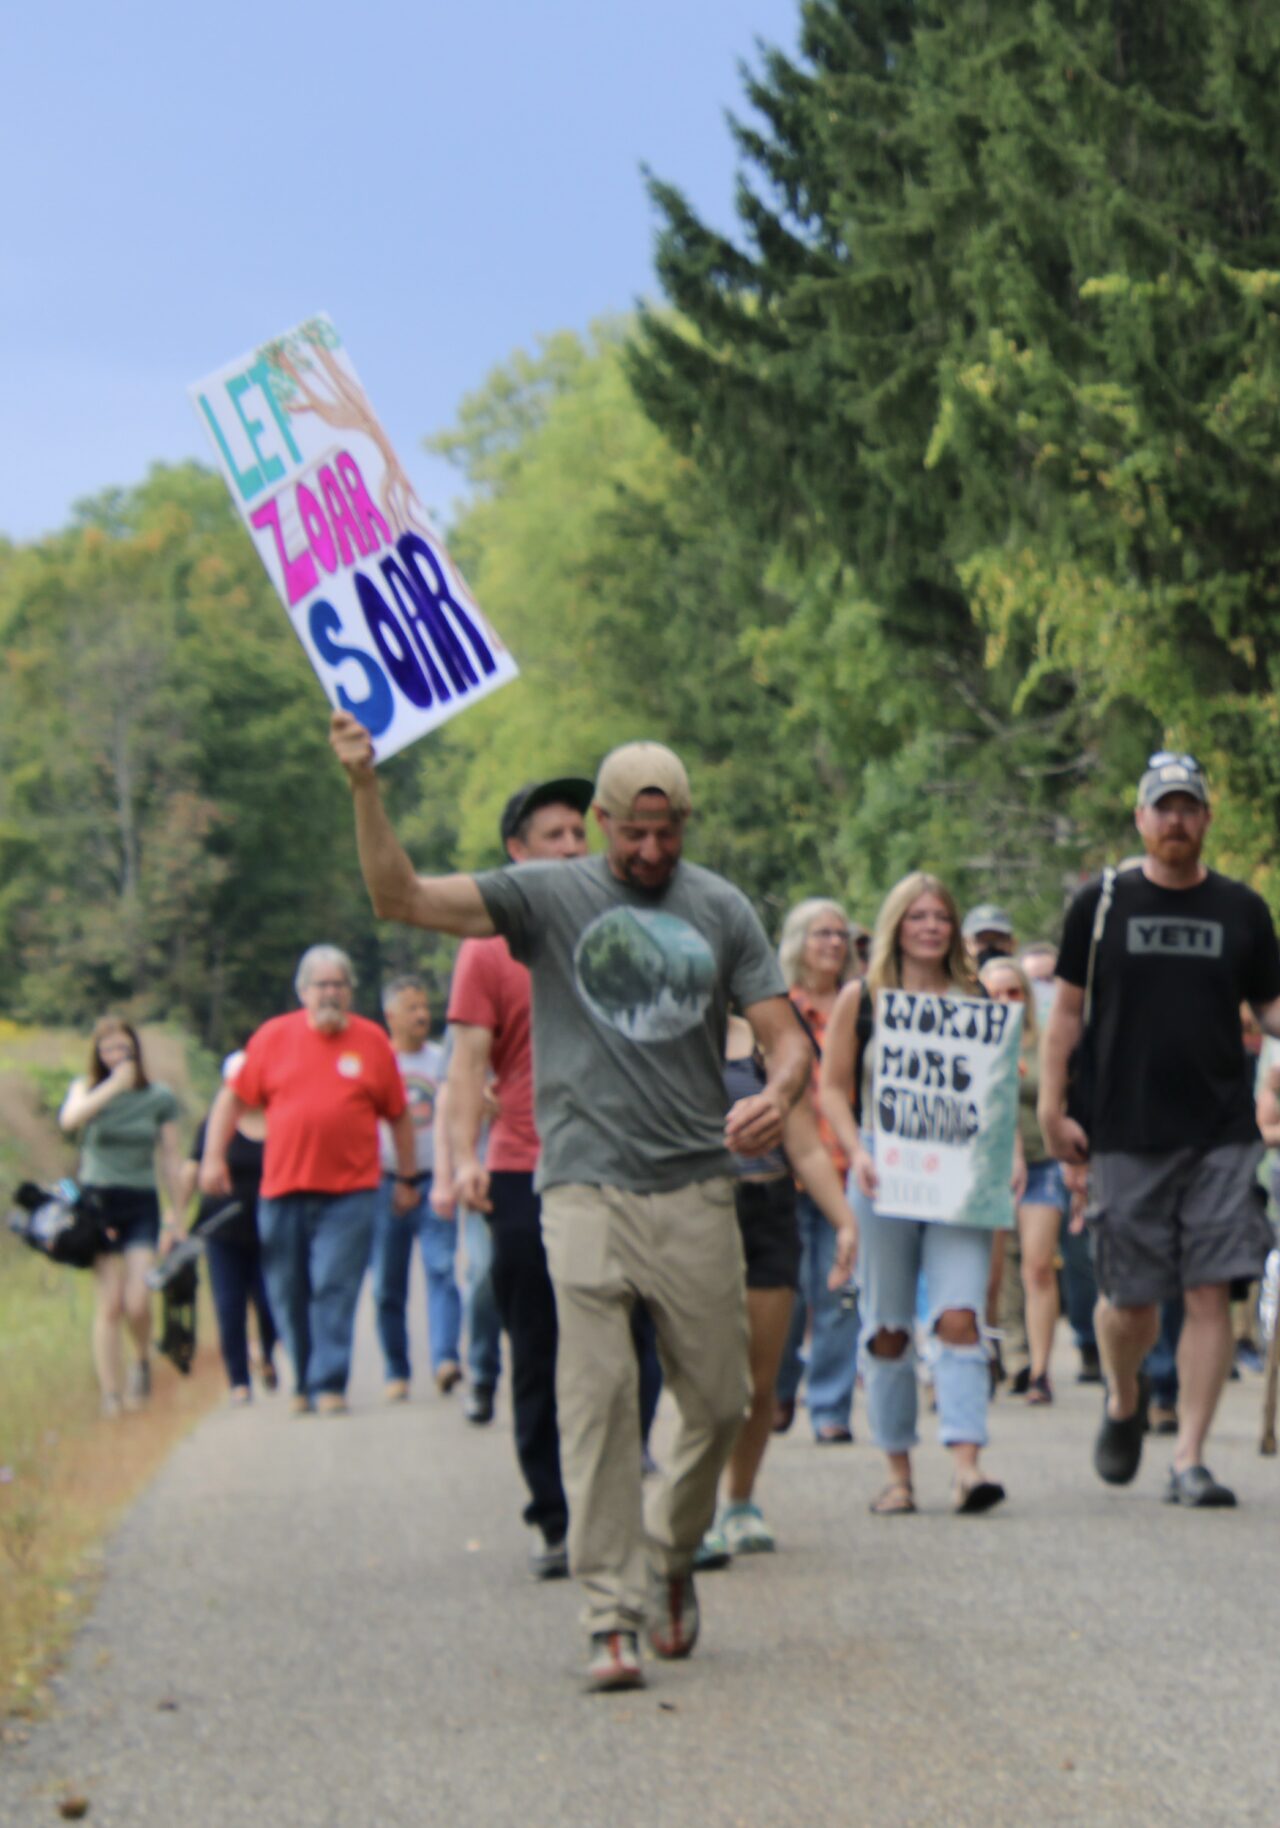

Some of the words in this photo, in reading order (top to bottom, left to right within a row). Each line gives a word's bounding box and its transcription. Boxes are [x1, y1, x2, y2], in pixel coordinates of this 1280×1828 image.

[199, 358, 303, 502] LET
[250, 450, 394, 607] ZOAR
[308, 530, 497, 738] SOAR
[1137, 925, 1213, 951] YETI
[884, 993, 1009, 1045] WORTH
[882, 1046, 972, 1093] MORE
